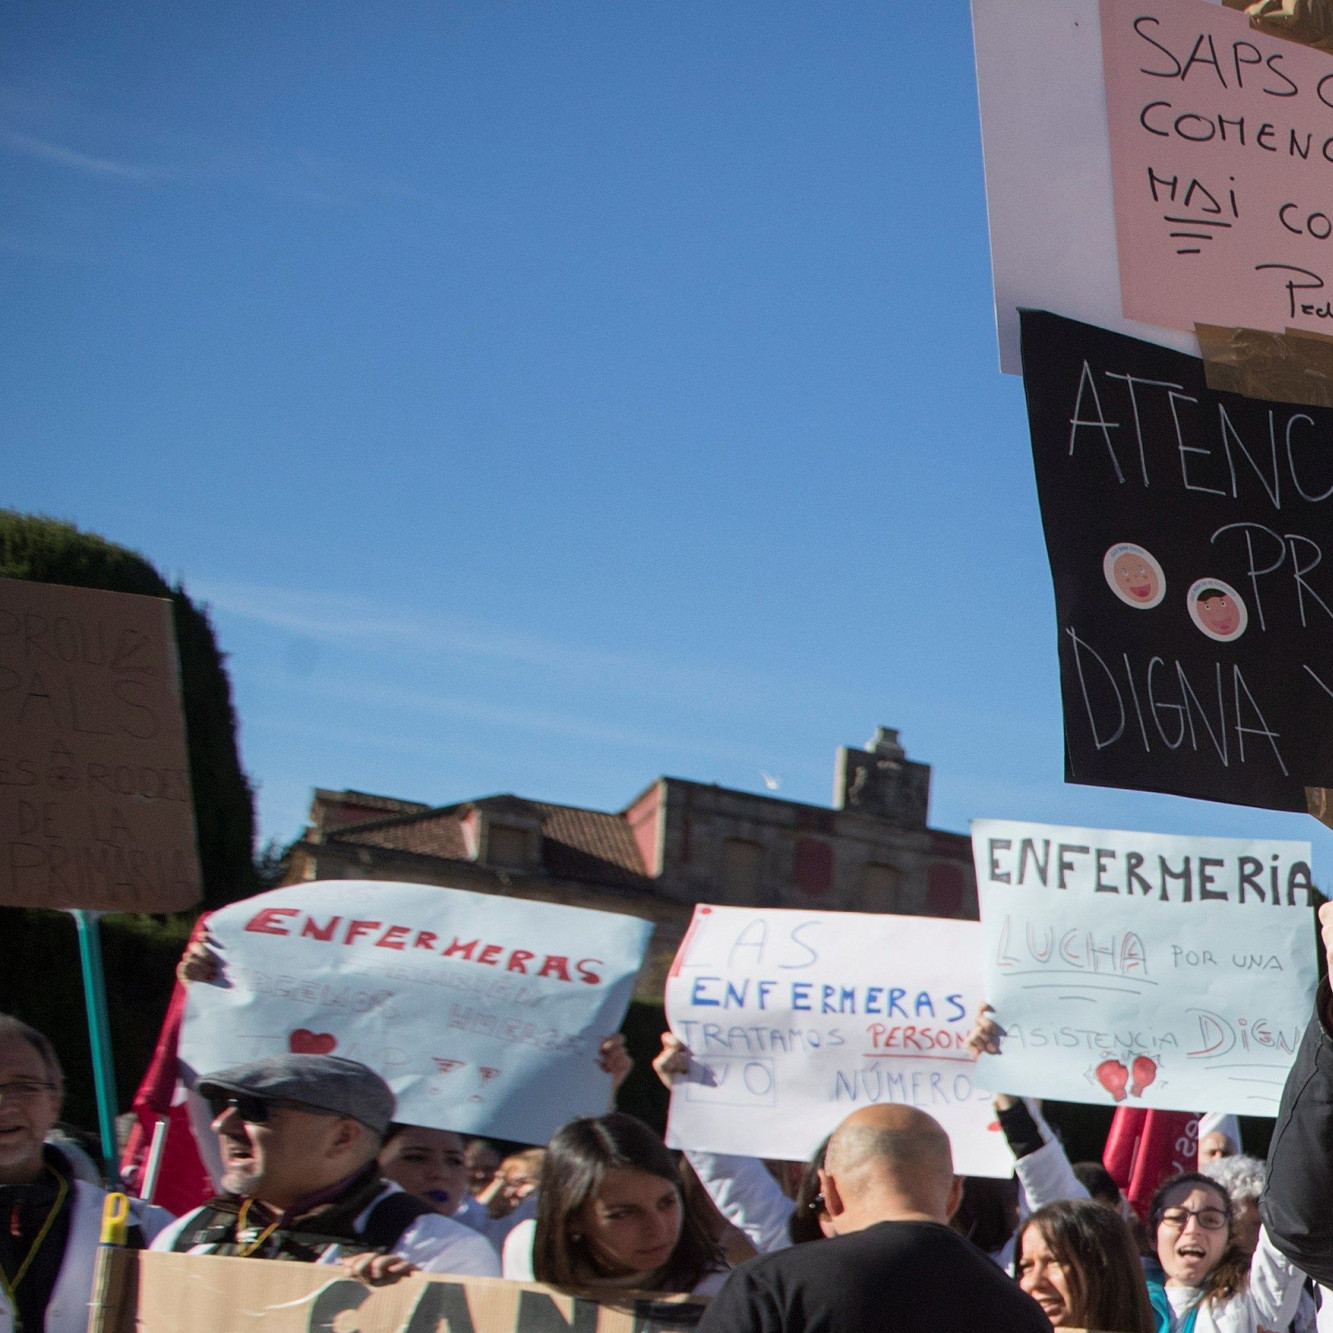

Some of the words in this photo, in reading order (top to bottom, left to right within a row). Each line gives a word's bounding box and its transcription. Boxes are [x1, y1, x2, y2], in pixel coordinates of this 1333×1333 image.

[1133, 16, 1299, 97] SAPS
[1064, 625, 1289, 778] DIGNA
[243, 906, 604, 986] ENFERMERAS
[996, 914, 1148, 976] LUCHA
[1171, 943, 1217, 969] POR
[1232, 954, 1284, 971] UNA
[690, 976, 966, 1022] ENFERMERAS
[678, 1019, 848, 1051] TRATAMOS
[866, 1022, 972, 1051] PERSON
